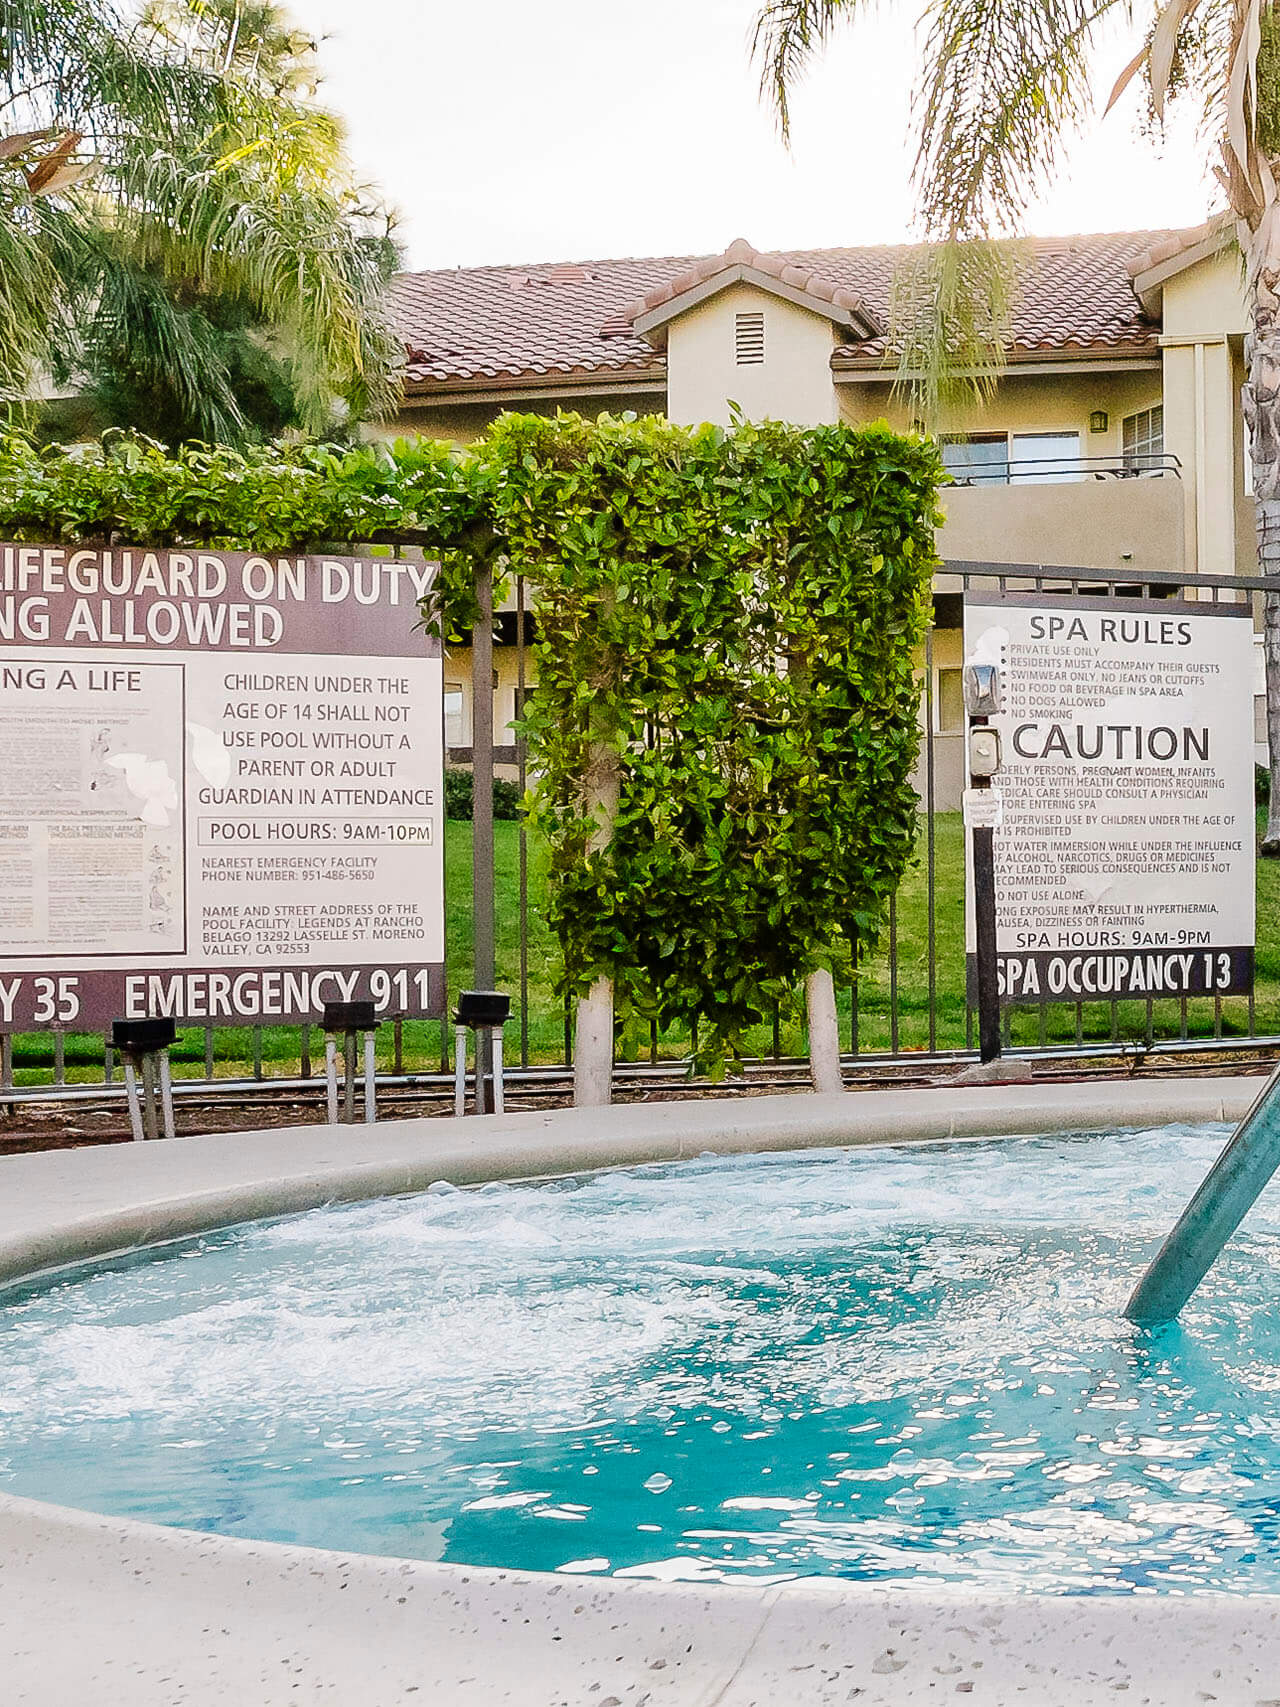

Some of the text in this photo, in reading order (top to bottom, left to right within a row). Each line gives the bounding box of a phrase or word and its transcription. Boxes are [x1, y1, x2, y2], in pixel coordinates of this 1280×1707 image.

[0, 549, 438, 604] IFEGUARD ON DUTY
[65, 600, 282, 645] ALLOWED
[1031, 616, 1191, 645] SPA RULES
[1010, 645, 1099, 656] PRIVATE USE ONLY
[1009, 659, 1219, 673] RESIDENTS MUST ACCOMPANY THEIR GUESTS
[56, 670, 77, 690] A
[89, 671, 141, 691] LIFE
[224, 674, 408, 694] CHILDREN UNDER THE
[1011, 671, 1069, 682] SWIMWEAR
[1102, 673, 1116, 683] NO
[1119, 674, 1147, 683] JEANS
[1149, 675, 1162, 684] OR
[1165, 675, 1204, 685] CUTOFFS
[1011, 684, 1183, 696] NO FOOD OR BEVERAGE IN SPA AREA
[1011, 697, 1105, 707] NO DOGS ALLOWED
[223, 703, 410, 721] AGE OF 14 SHALL NOT
[1011, 710, 1072, 719] NO SMOKING
[223, 731, 411, 749] USE POOL WITHOUT A
[1013, 724, 1208, 760] CAUTION
[239, 760, 396, 776] PARENT OR ADULT
[1082, 767, 1132, 777] PREGNANT
[1176, 768, 1215, 777] INFANTS
[1013, 778, 1045, 787] THOSE
[1048, 778, 1073, 787] WITH
[1075, 778, 1114, 787] HEALTH
[1114, 778, 1174, 788] CONDITIONS
[1174, 779, 1224, 788] REQUIRING
[199, 788, 433, 805] GUARDIAN IN ATTENDANCE
[1036, 789, 1208, 799] CARE SHOULD CONSULT A PHYSICIAN
[1030, 801, 1096, 809] ENTERING SPA
[1002, 816, 1061, 825] SUPERVISED
[1065, 816, 1082, 824] USE
[1086, 816, 1097, 824] BY
[1101, 816, 1146, 825] CHILDREN
[1149, 816, 1180, 825] UNDER
[1183, 816, 1199, 825] THE
[1203, 816, 1220, 825] AGE
[1224, 816, 1235, 825] OF
[211, 824, 429, 840] POOL HOURS: 9AM-10PM
[1004, 827, 1071, 836] IS PROHIBITED
[1013, 842, 1049, 851] WATER
[1051, 842, 1108, 851] IMMERSION
[1108, 842, 1139, 851] WHILE
[1139, 842, 1173, 851] UNDER
[1173, 842, 1194, 851] THE
[1194, 842, 1242, 851] INFLUENCE
[202, 857, 377, 868] NEAREST EMERGENCY FACILITY
[1115, 853, 1149, 862] DRUGS
[1149, 853, 1165, 862] OR
[1165, 852, 1216, 862] MEDICINES
[1015, 864, 1040, 873] LEAD
[1044, 864, 1056, 873] TO
[1060, 864, 1099, 873] SERIOUS
[1102, 864, 1177, 873] CONSEQUENCES
[1177, 864, 1198, 872] AND
[1202, 864, 1209, 873] IS
[1211, 864, 1230, 872] NOT
[202, 871, 241, 881] PHONE
[996, 876, 1066, 885] ECOMMENDED
[1008, 891, 1029, 900] NOT
[1032, 891, 1048, 900] USE
[203, 904, 417, 916] NAME AND STREET ADDRESS OF THE
[1020, 906, 1071, 916] EXPOSURE
[1073, 905, 1096, 915] MAY
[1096, 905, 1131, 915] RESULT
[1134, 905, 1144, 915] IN
[203, 920, 236, 930] POOL
[299, 918, 350, 928] LEGENDS
[355, 917, 370, 928] AT
[374, 917, 423, 927] RANCHO
[997, 916, 1144, 927] AUSEA, DIZZINESS OR FAINTING
[203, 932, 251, 942] BELAGO
[256, 931, 290, 941] 13292
[294, 930, 348, 940] LASSELLE
[373, 929, 424, 939] MORENO
[1017, 930, 1210, 947] SPA HOURS: 9AM-9PM
[256, 944, 272, 954] CA
[276, 943, 309, 954] 92553
[997, 954, 1230, 994] SPA OCCUPANCY 13
[35, 978, 78, 1021] 35
[126, 972, 360, 1017] EMERGENCY
[371, 970, 427, 1011] 911
